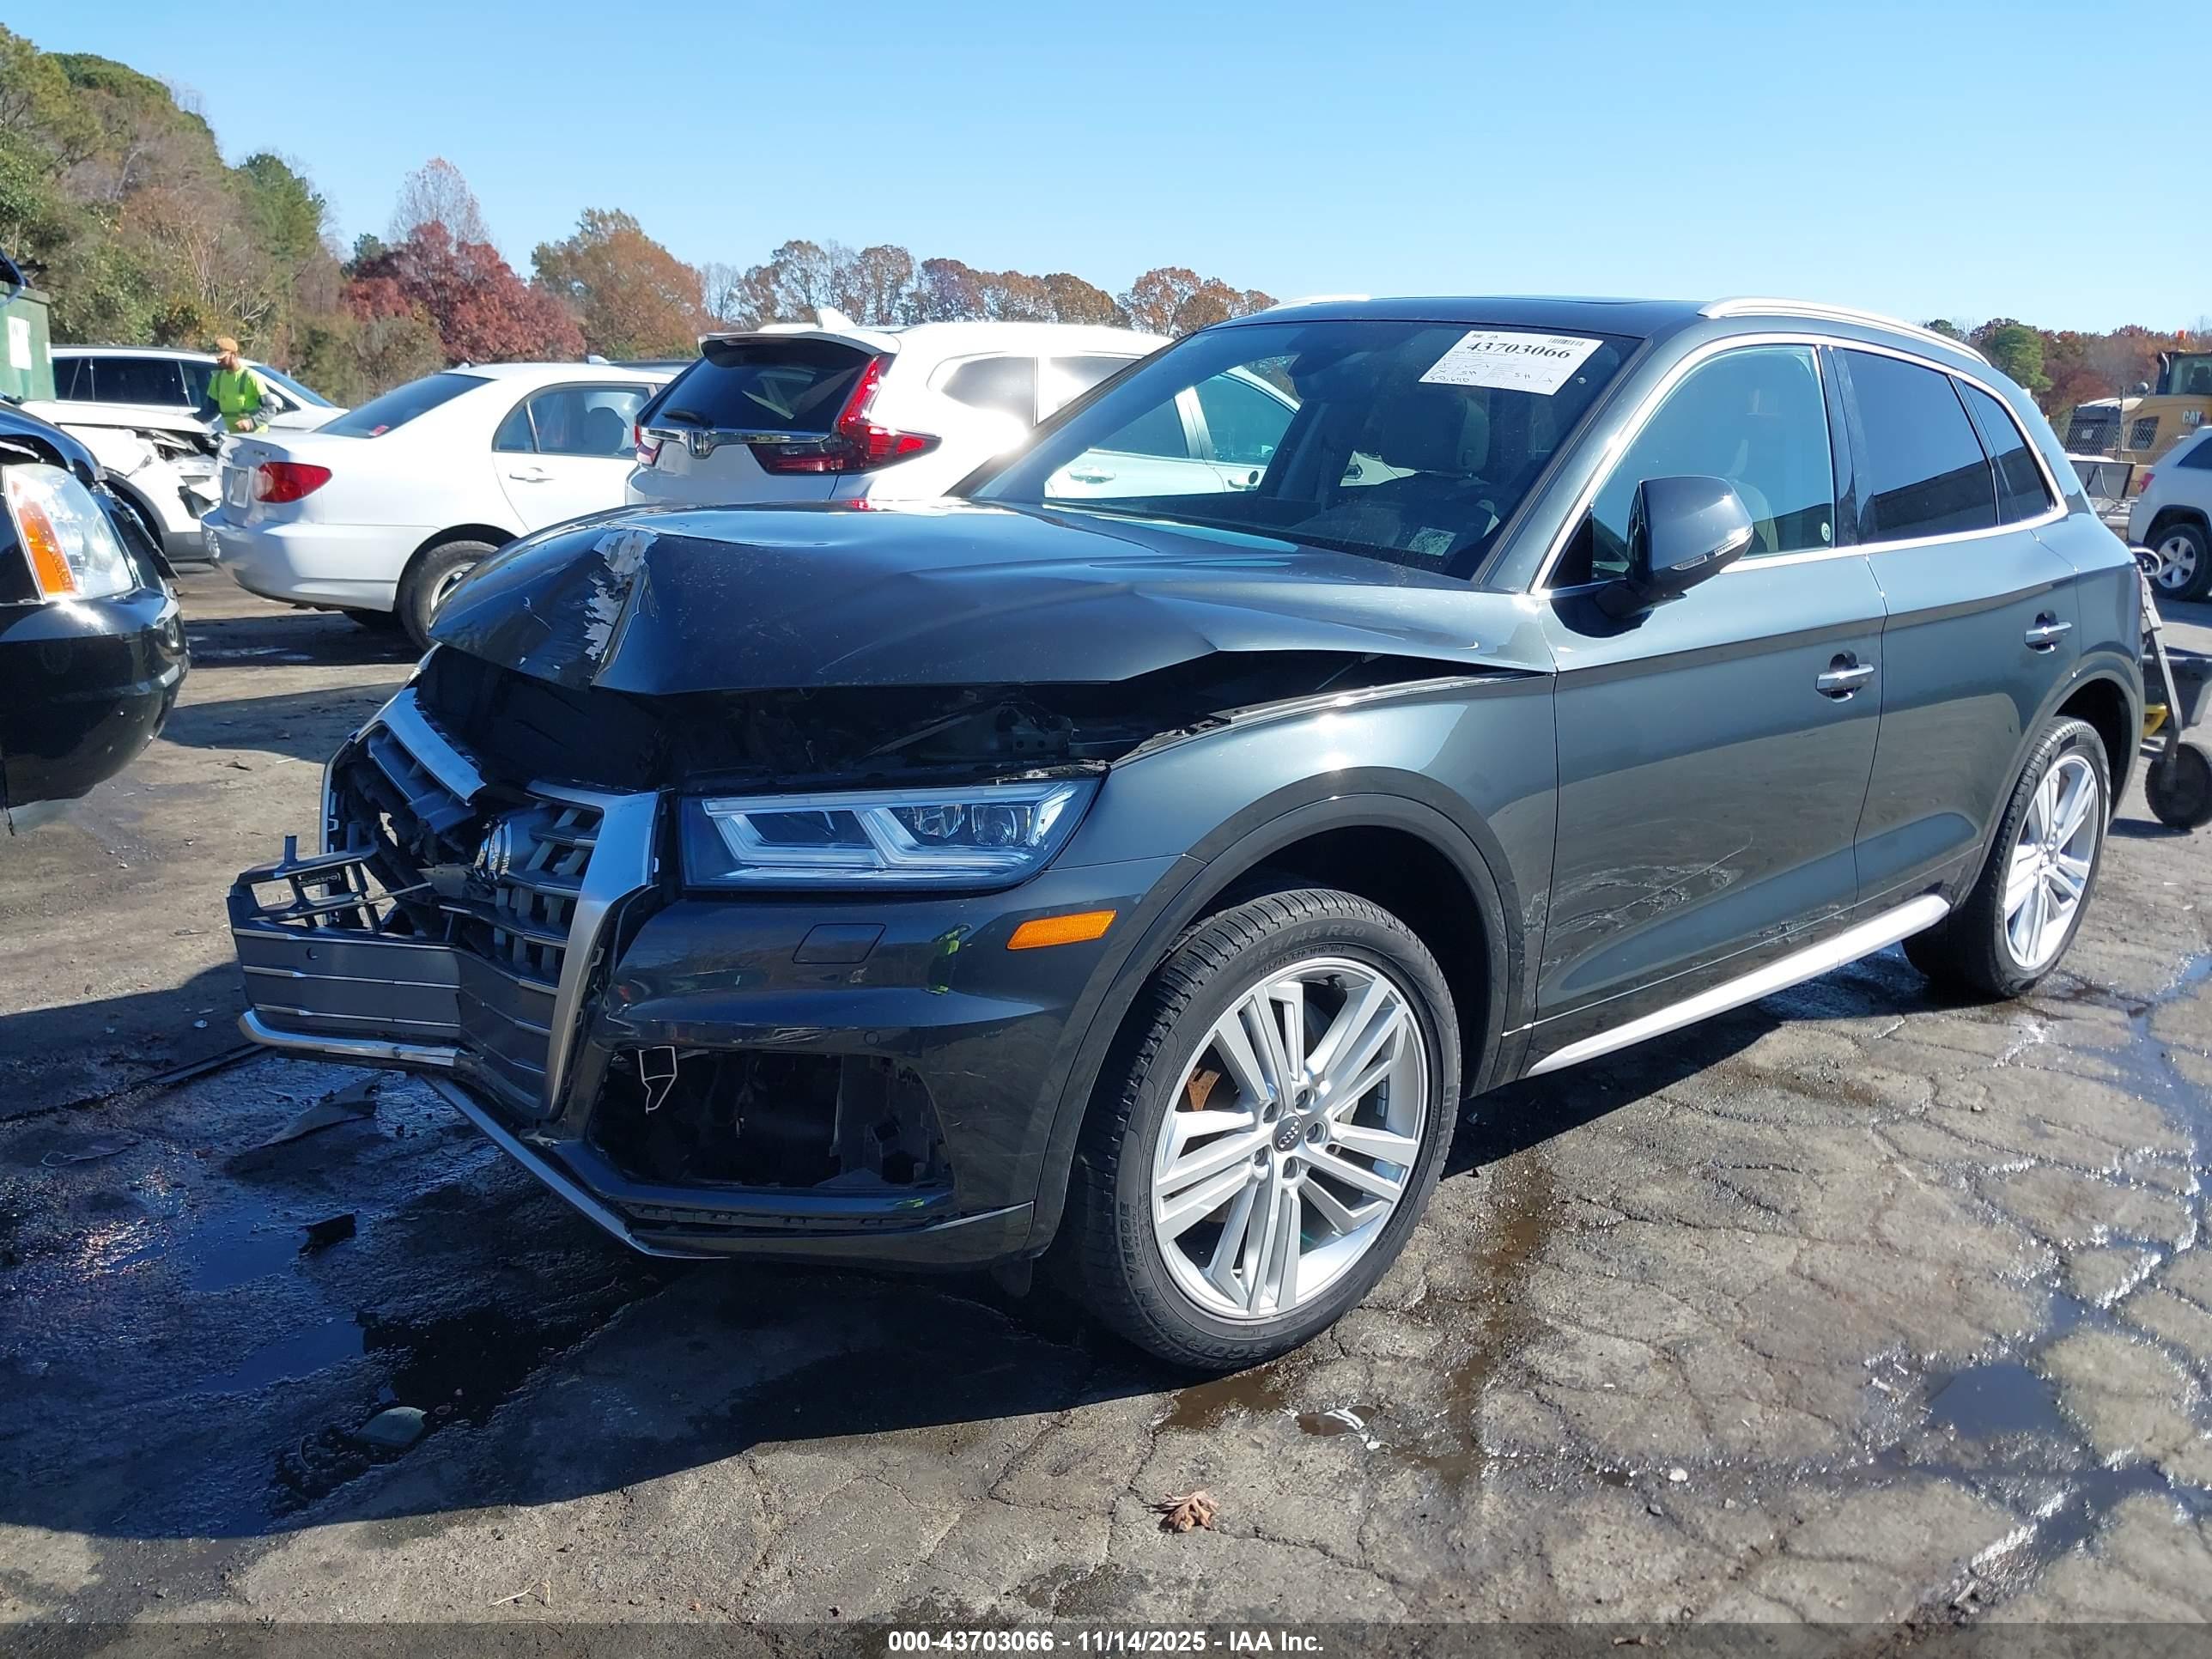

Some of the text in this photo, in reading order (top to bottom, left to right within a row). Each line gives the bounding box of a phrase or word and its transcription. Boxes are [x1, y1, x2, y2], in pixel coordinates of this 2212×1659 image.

[1466, 341, 1573, 359] 43703066
[2182, 410, 2203, 426] CAT
[1327, 924, 1366, 938] R20
